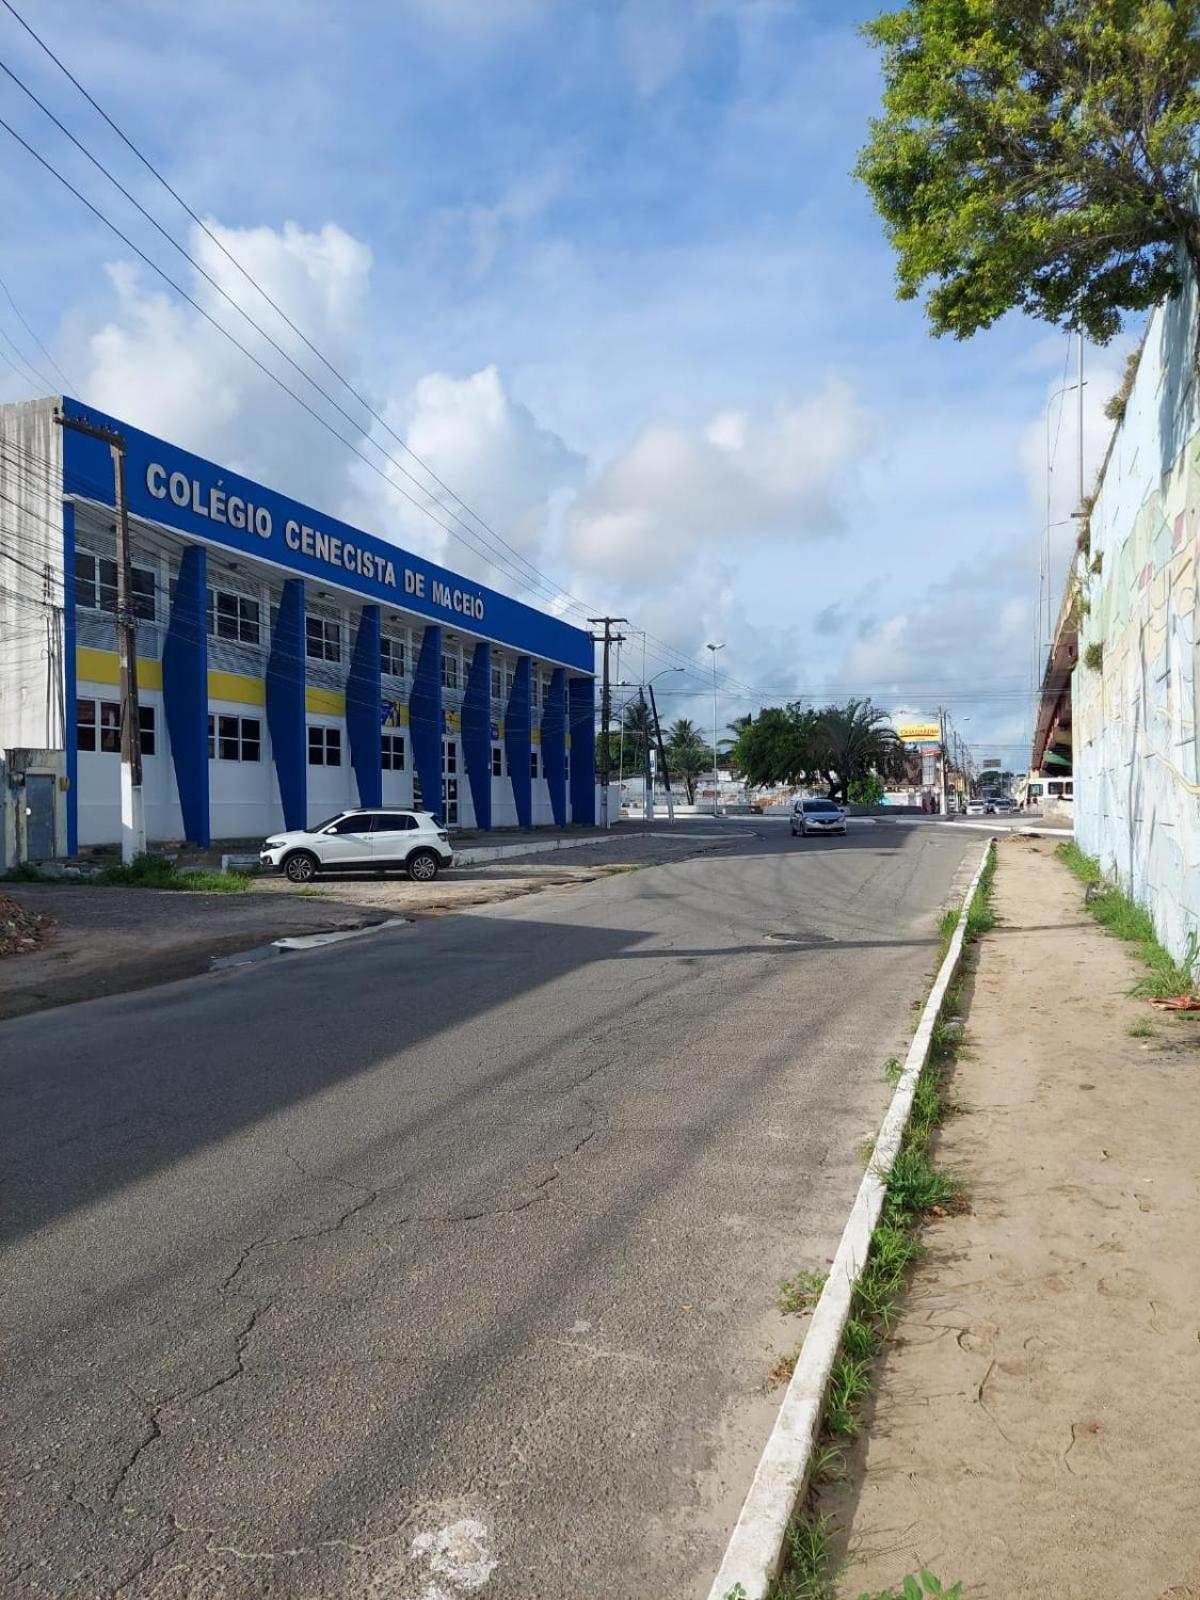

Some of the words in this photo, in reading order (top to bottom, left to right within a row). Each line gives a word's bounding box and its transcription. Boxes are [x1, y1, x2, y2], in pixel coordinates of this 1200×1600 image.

[146, 463, 273, 540] COLÉGIO
[285, 520, 396, 588] CENECISTA
[404, 568, 425, 598] DE
[432, 580, 484, 621] MACEIÓ
